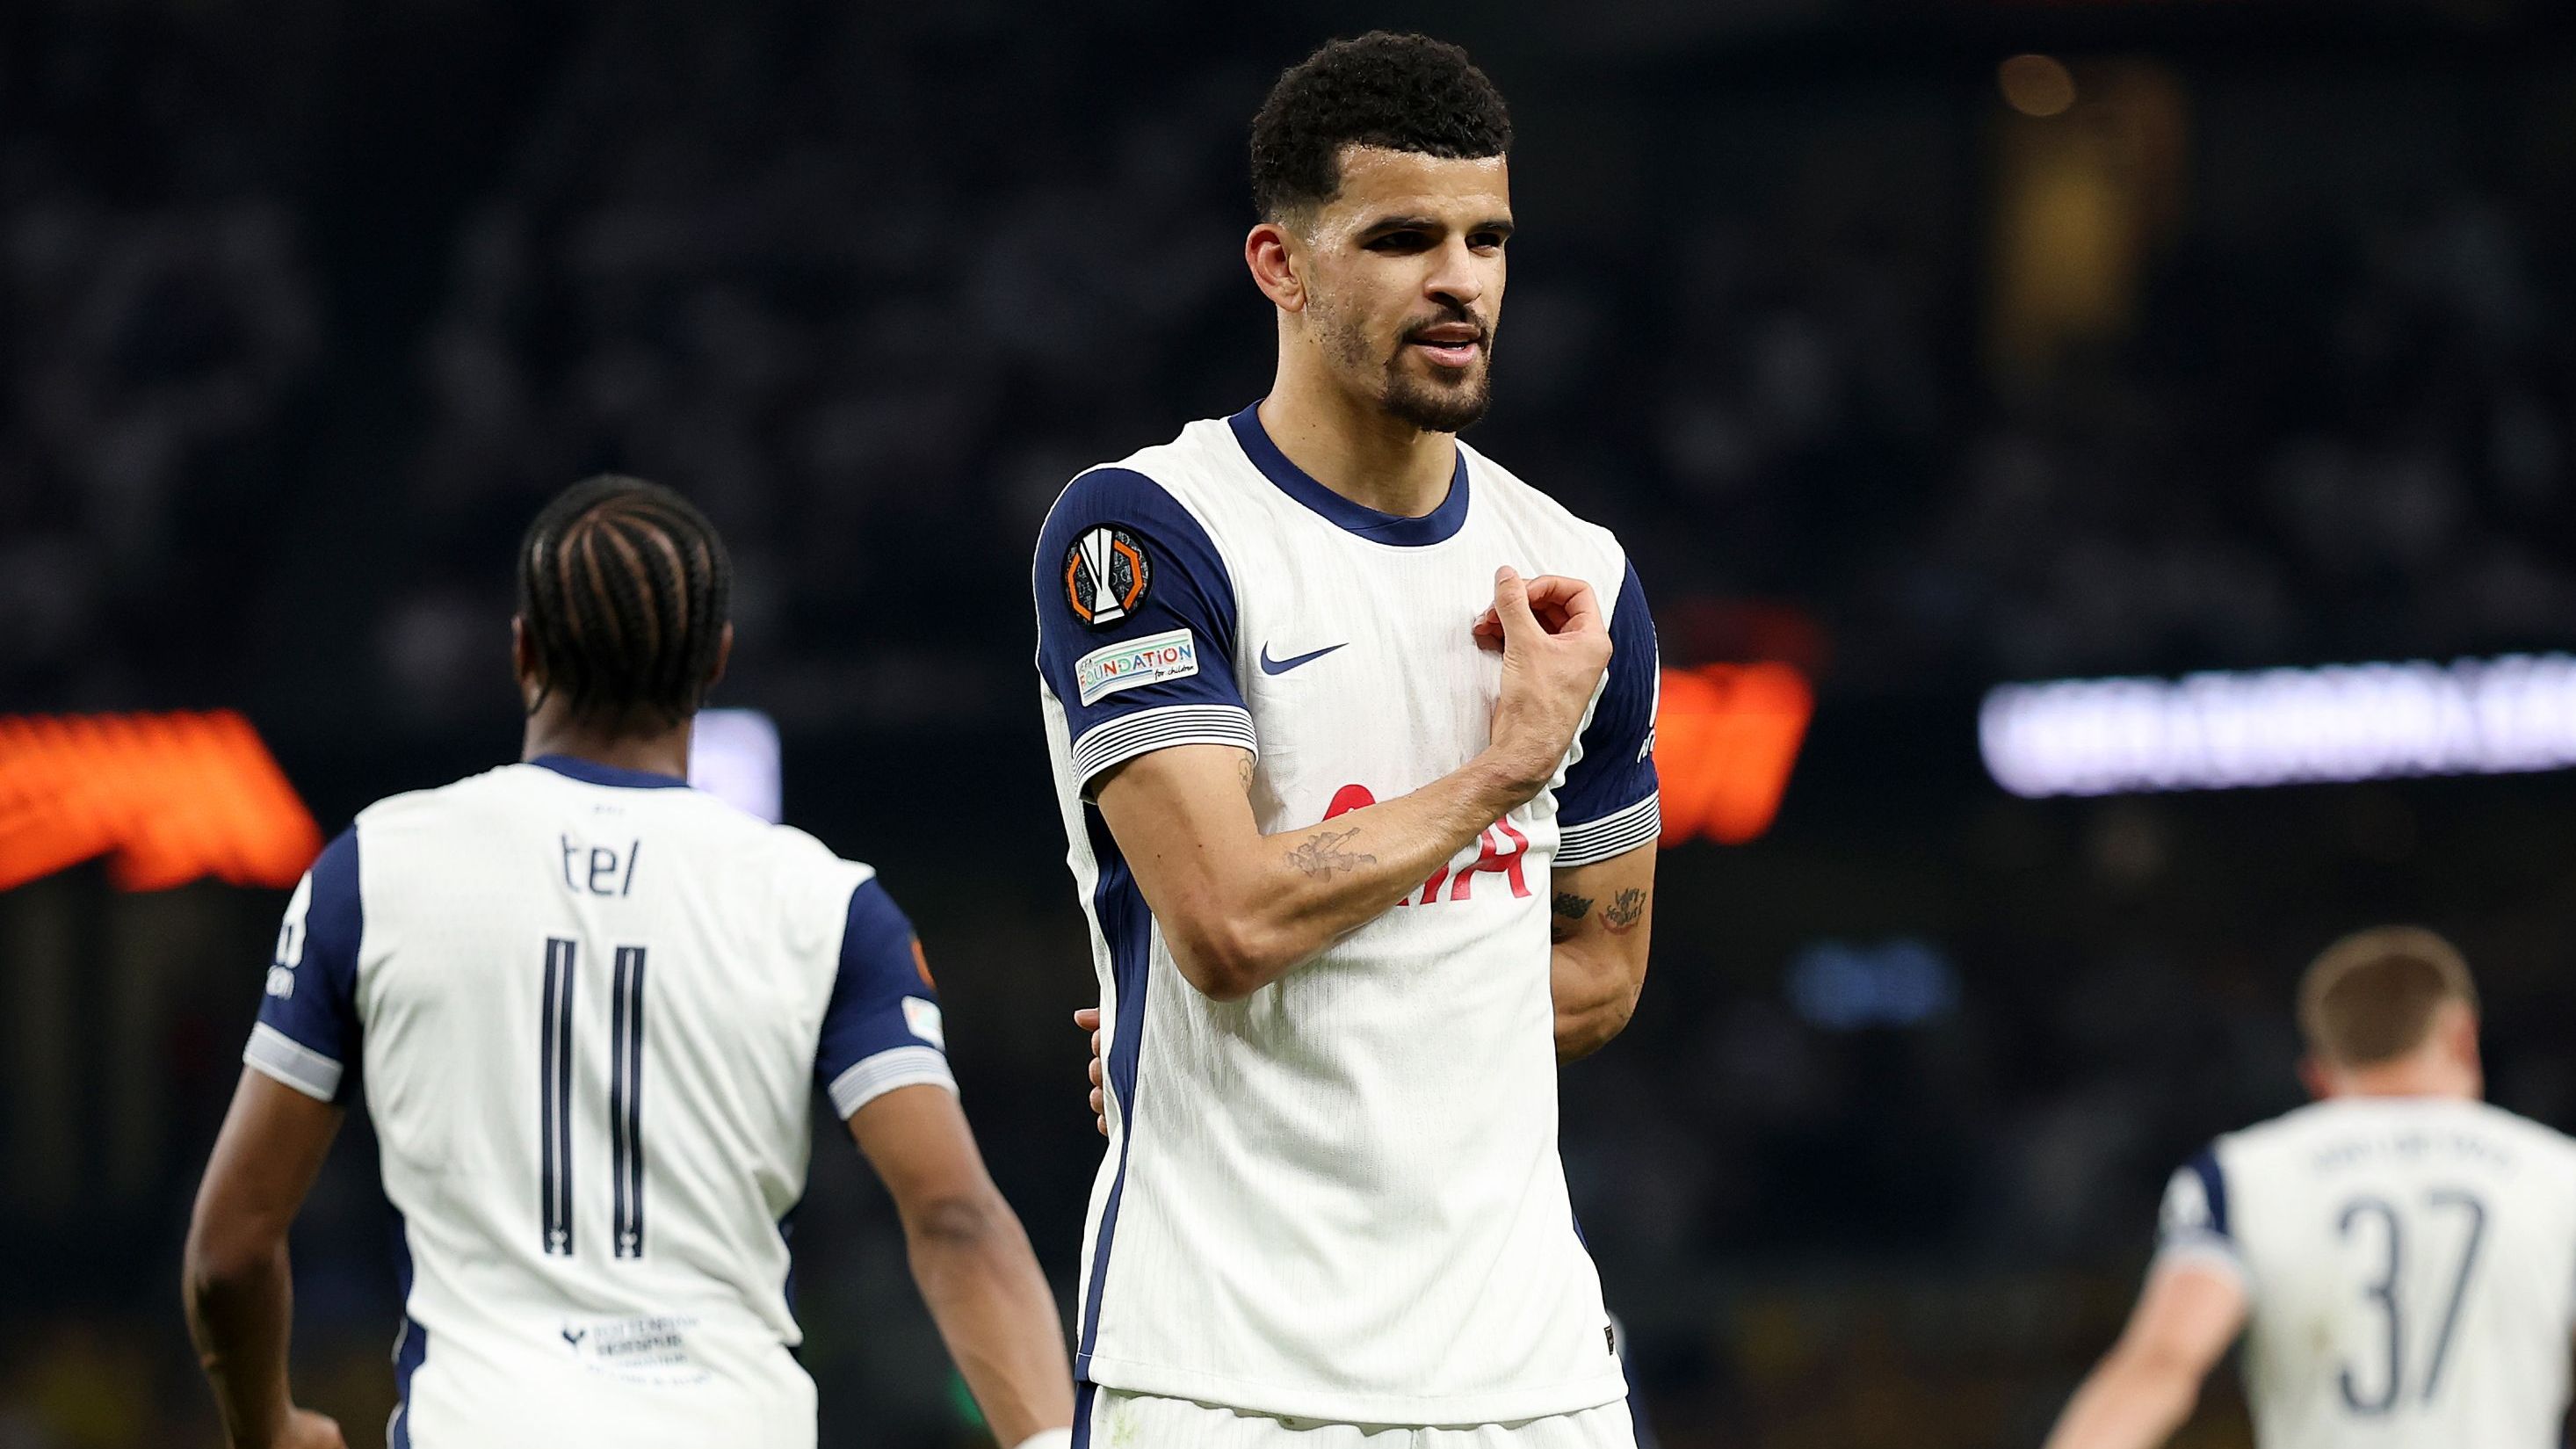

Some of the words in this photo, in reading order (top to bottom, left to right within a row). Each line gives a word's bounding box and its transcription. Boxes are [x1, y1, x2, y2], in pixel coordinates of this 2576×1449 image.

[1154, 669, 1165, 681] for
[1168, 665, 1194, 676] children
[560, 833, 640, 896] tel
[541, 938, 646, 1258] 11
[2337, 1189, 2486, 1417] 37
